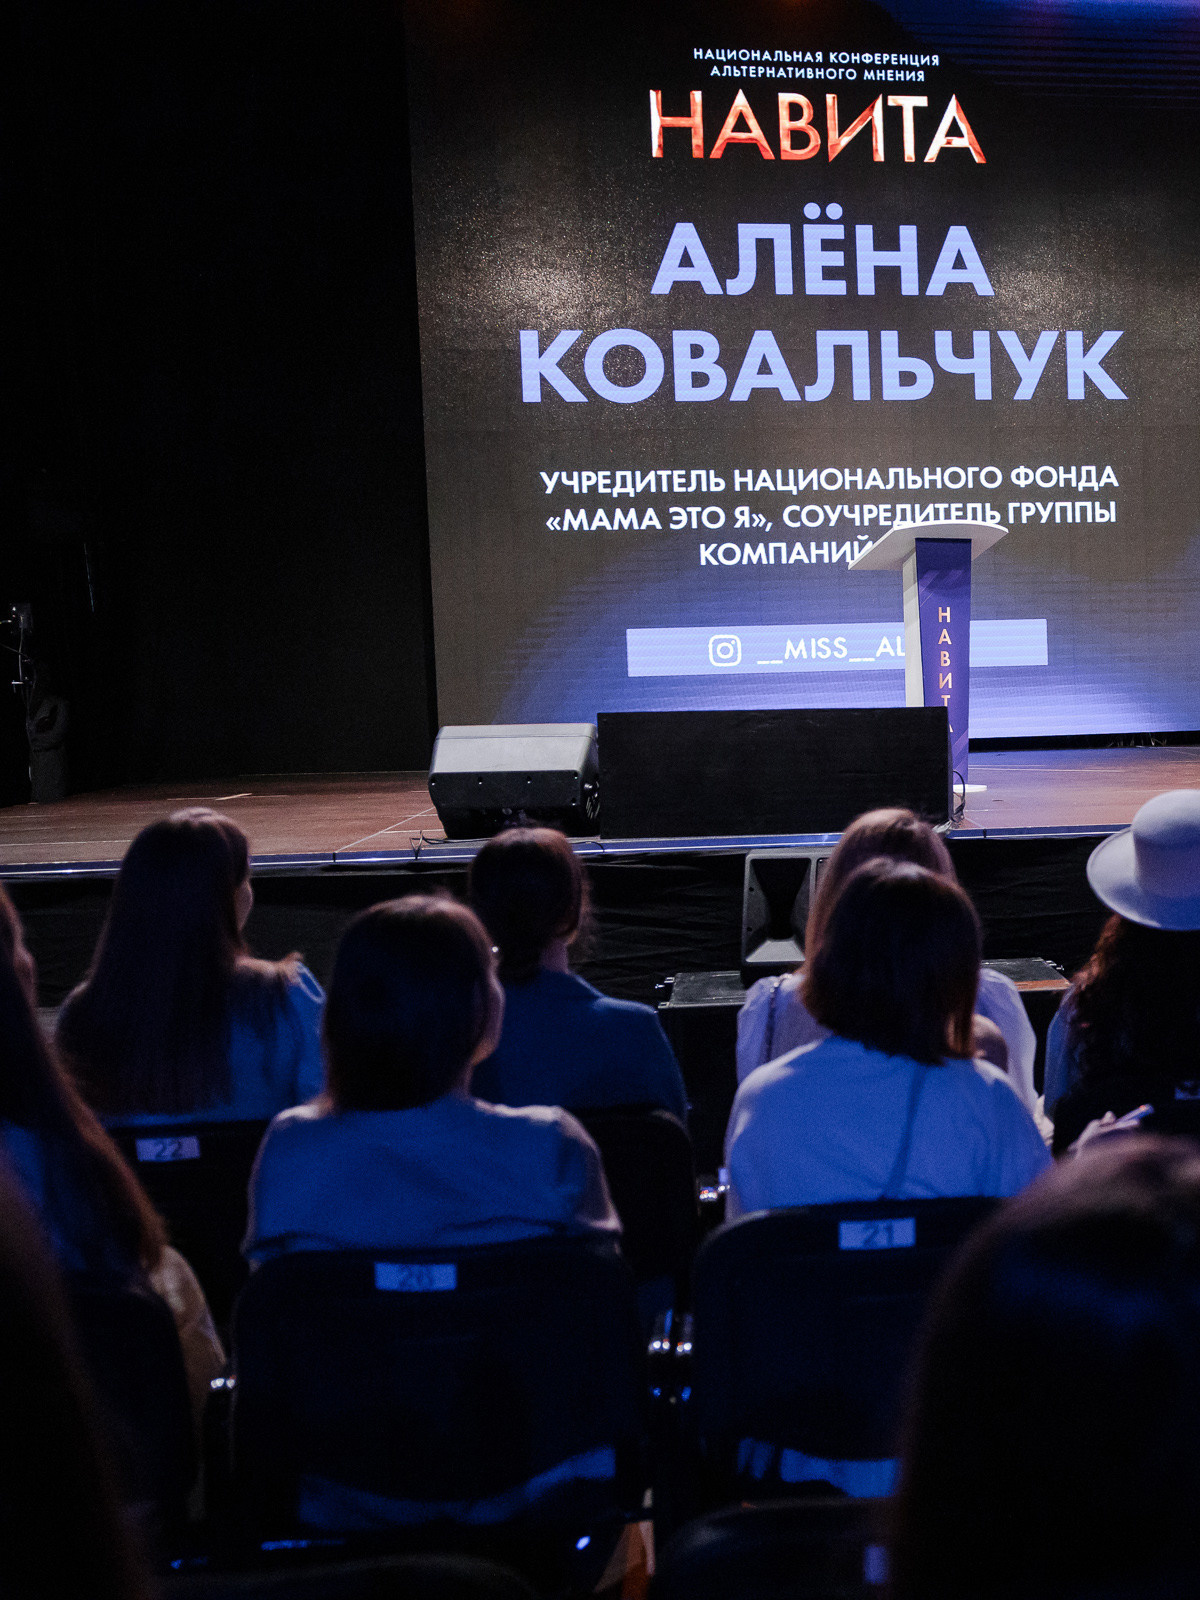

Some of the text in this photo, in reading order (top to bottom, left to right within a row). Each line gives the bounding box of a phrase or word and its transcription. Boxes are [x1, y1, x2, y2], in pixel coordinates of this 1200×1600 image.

[693, 47, 940, 66] НАЦИОНАЛЬНАЯ КОНФЕРЕНЦИЯ
[710, 65, 925, 82] АЛЬТЕРНАТИВНОГО МНЕНИЯ
[649, 88, 987, 164] НАВИТА
[650, 202, 995, 296] АЛЁНА
[519, 328, 1129, 404] КОВАЛЬЧУК
[539, 465, 1120, 498] УЧРЕДИТЕЛЬ НАЦИОНАЛЬНОГО ФОНДА
[545, 500, 1117, 532] «МАМА ЭТО Я», СОУЧРЕДИТЕЛЬ ГРУППЫ
[937, 606, 954, 733] НАВИТ
[153, 1138, 183, 1161] 22
[862, 1221, 895, 1249] 21
